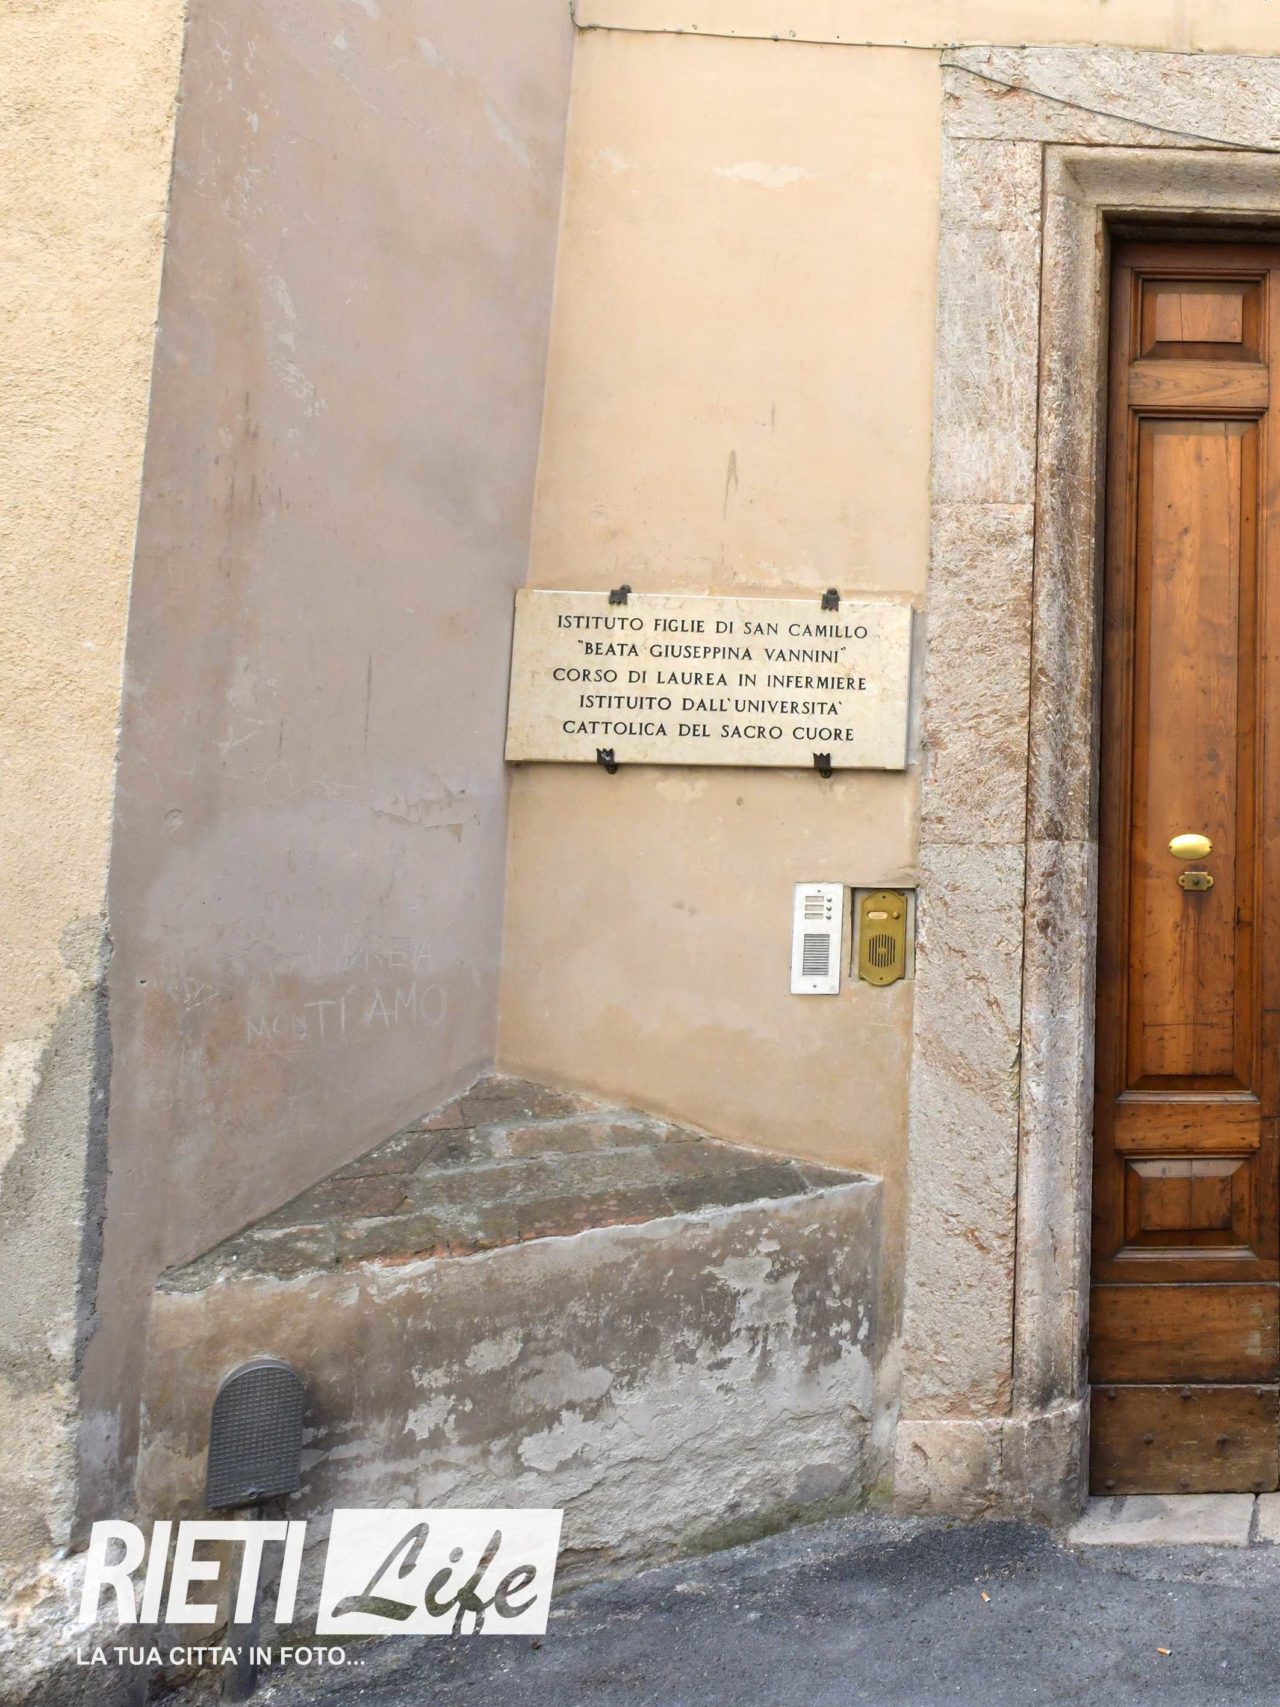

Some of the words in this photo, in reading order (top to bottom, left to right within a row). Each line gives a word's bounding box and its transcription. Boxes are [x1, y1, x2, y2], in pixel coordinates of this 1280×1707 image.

[557, 615, 644, 631] ISTITUTO
[653, 618, 705, 633] FIGLIE
[715, 620, 734, 634] DI
[743, 621, 779, 636] SAN
[788, 623, 868, 639] CAMILLO
[649, 644, 753, 661] GIUSEPPINA
[552, 667, 618, 683] CORSO
[628, 670, 647, 684] DI
[656, 671, 728, 686] LAUREA
[738, 673, 757, 687] IN
[767, 674, 867, 691] INFERMIERE
[579, 694, 672, 711] ISTITUITO
[562, 720, 667, 737] CATTOLICA
[678, 723, 711, 738] DEL
[720, 724, 783, 740] SACRO
[792, 726, 855, 742] CUORE
